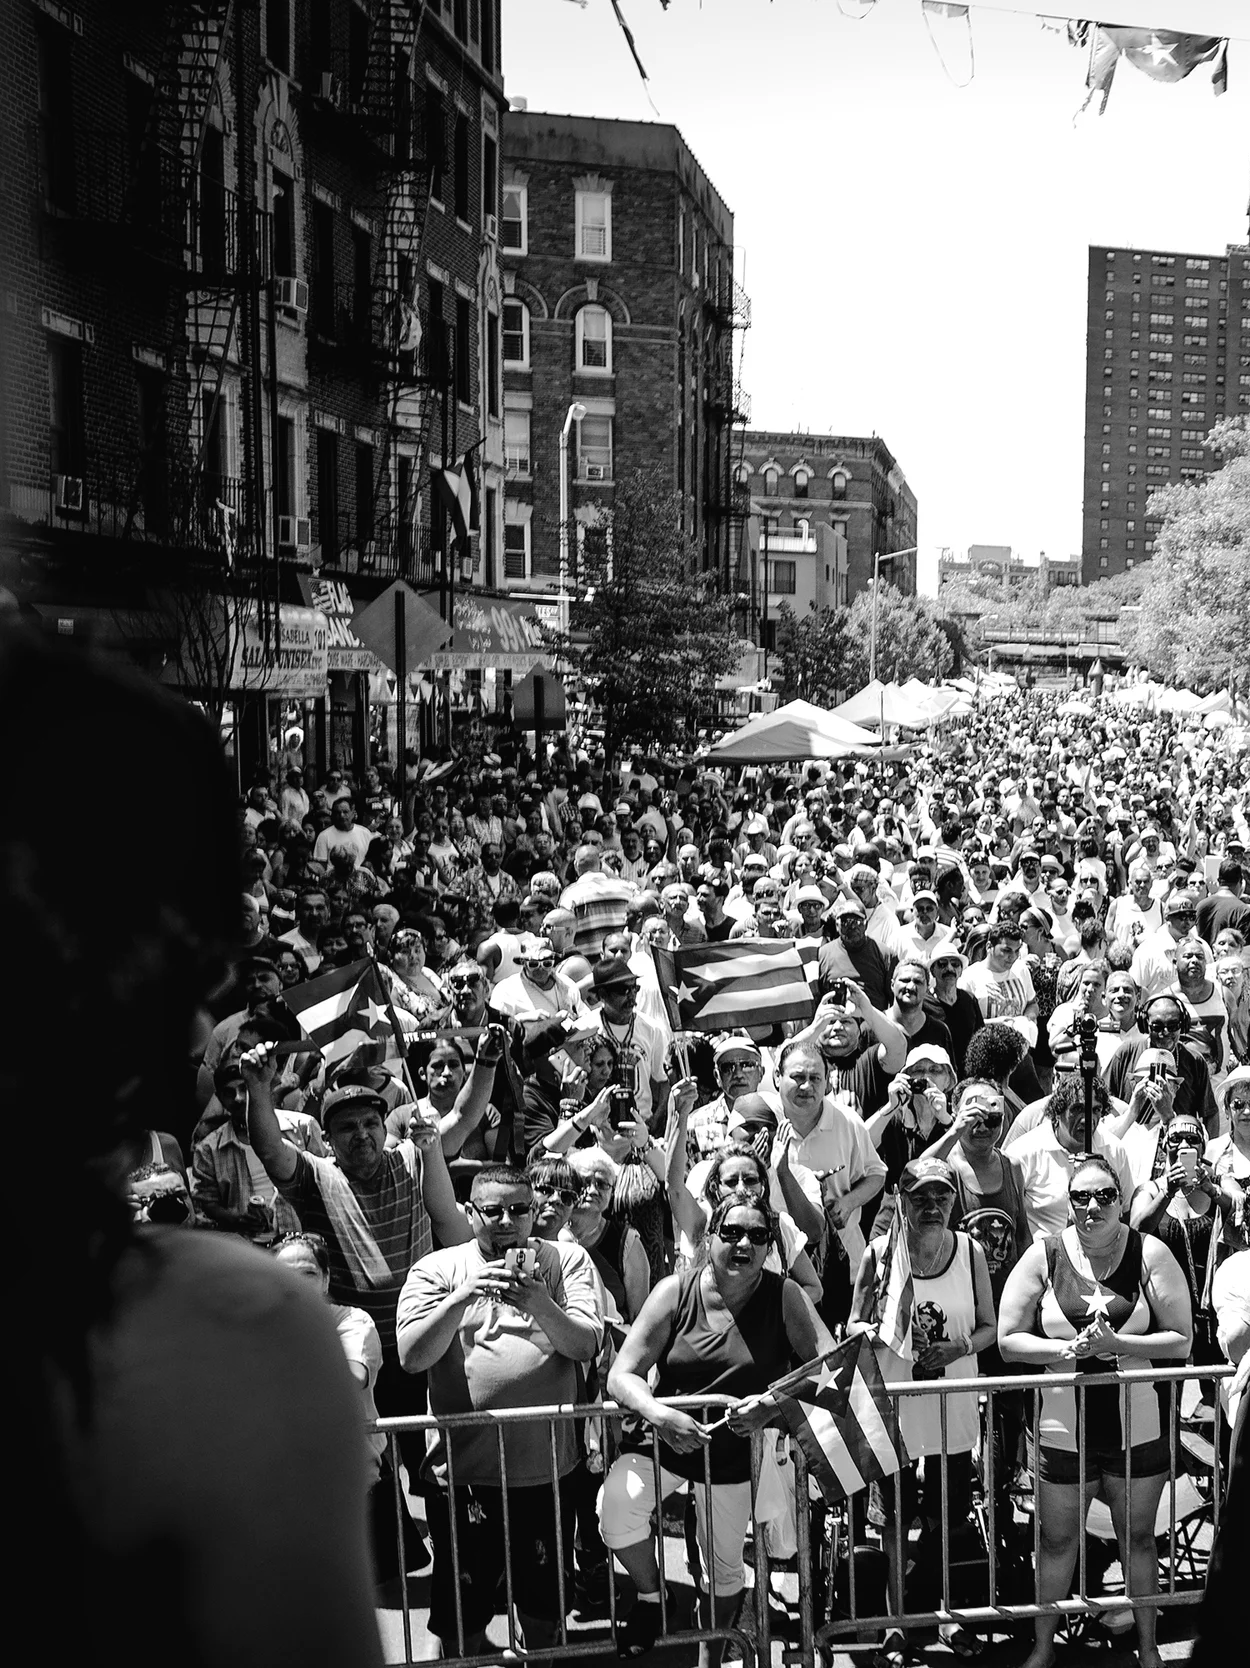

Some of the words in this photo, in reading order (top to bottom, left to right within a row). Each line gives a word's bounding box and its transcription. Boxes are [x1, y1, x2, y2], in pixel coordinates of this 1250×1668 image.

[326, 581, 355, 614] FLAG
[280, 628, 310, 645] SABELLA
[240, 645, 275, 668] SAL
